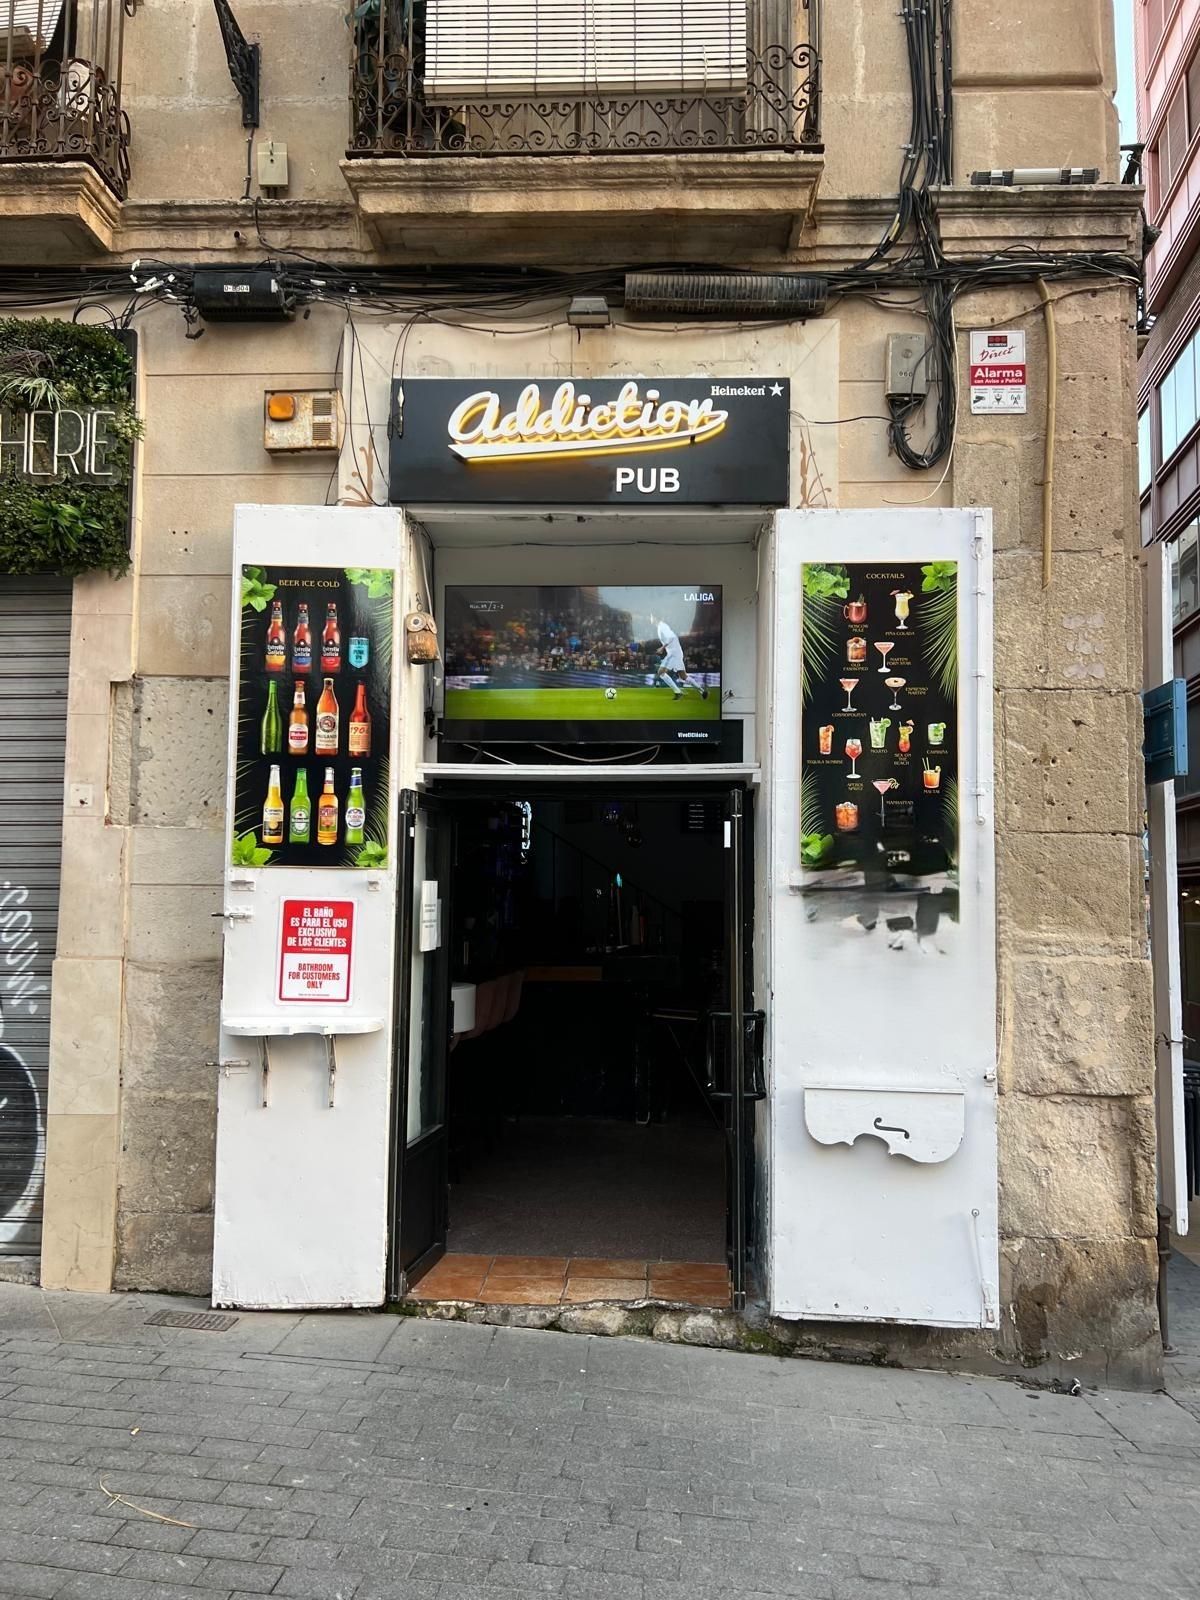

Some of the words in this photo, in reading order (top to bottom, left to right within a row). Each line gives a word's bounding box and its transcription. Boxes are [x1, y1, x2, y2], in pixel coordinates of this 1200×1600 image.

[980, 345, 1018, 361] Direct
[974, 367, 1023, 378] Alarma
[711, 385, 766, 396] Heineken
[448, 381, 729, 446] Addiction
[615, 467, 680, 493] PUB
[279, 579, 300, 587] BEER
[317, 580, 340, 588] COLD
[683, 592, 714, 601] LALIGA
[303, 907, 313, 917] EL
[313, 906, 334, 918] BAÑO
[290, 917, 301, 927] ES
[301, 917, 321, 927] PARA
[322, 918, 331, 928] EL
[332, 918, 348, 928] USO
[297, 927, 337, 937] EXCLUSIVO
[287, 936, 297, 947] DE
[298, 937, 313, 947] LOS
[313, 937, 347, 948] CLIENTES
[298, 962, 334, 972] BATHROOM
[288, 971, 301, 980] FOR
[301, 972, 341, 981] CUSTOMERS
[306, 980, 323, 989] ONLY
